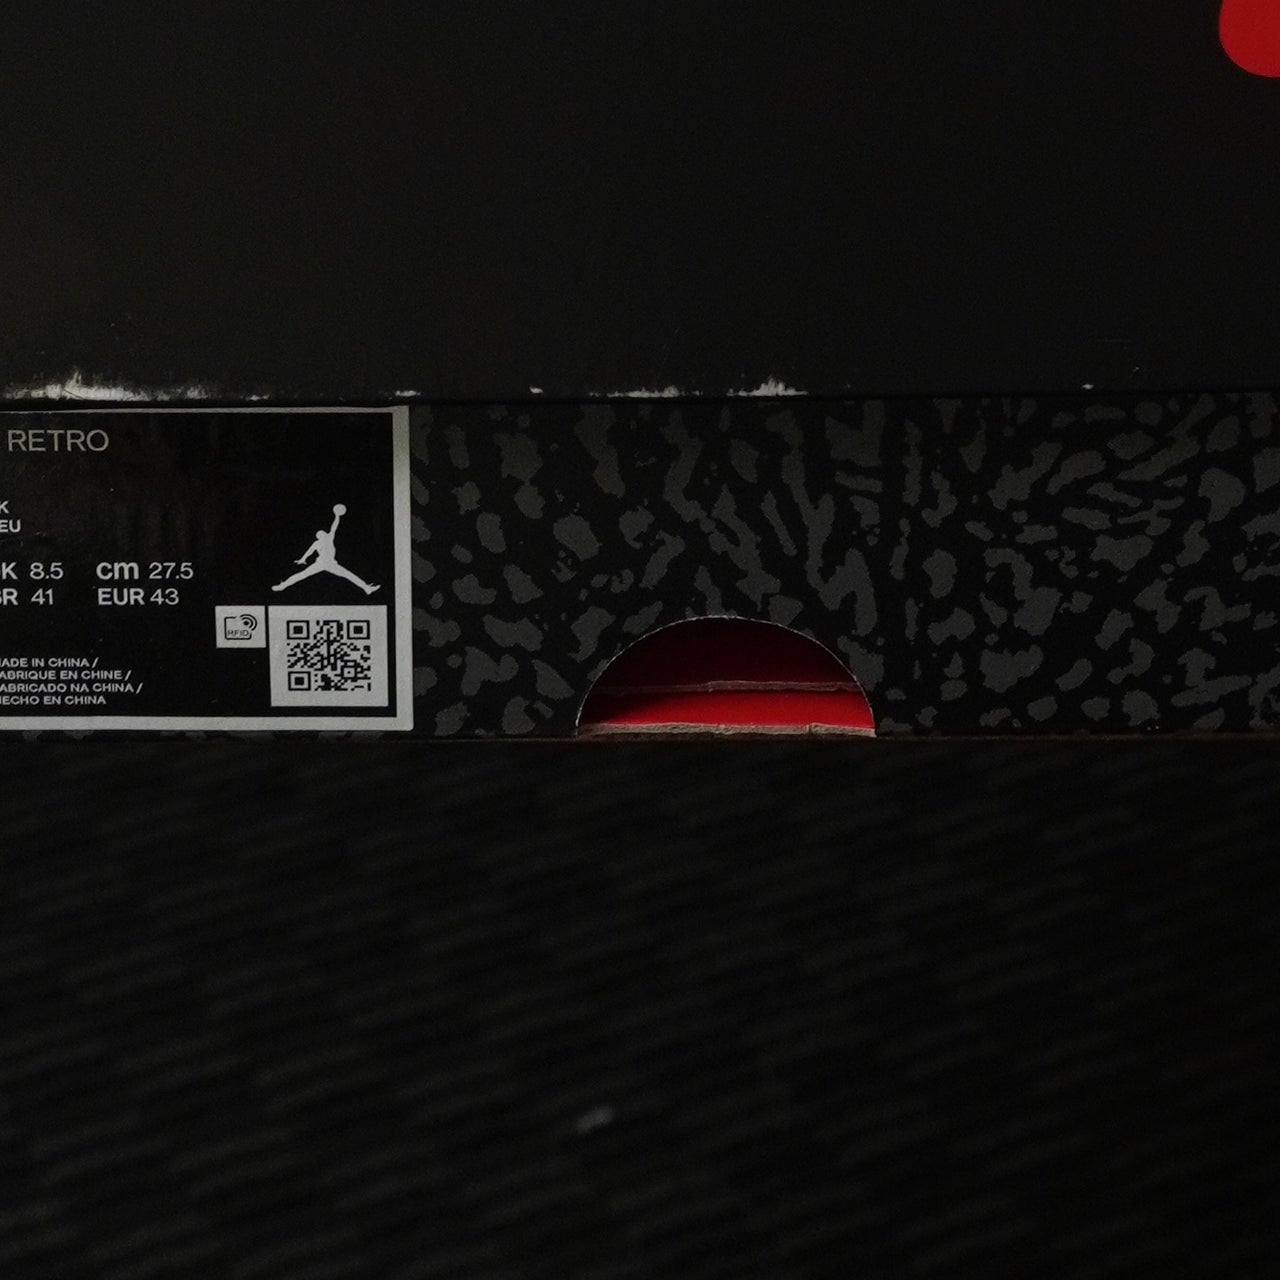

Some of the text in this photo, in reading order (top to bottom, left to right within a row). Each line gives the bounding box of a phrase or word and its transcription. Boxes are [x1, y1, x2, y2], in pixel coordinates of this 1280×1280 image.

[7, 429, 110, 452] RETRO
[29, 561, 64, 580] 8.5
[96, 561, 140, 580] cm
[148, 561, 194, 580] 27.5
[30, 588, 55, 605] 41
[97, 587, 145, 606] EUR
[150, 587, 180, 606] 43
[31, 657, 45, 668] IN
[47, 657, 90, 668] CHINA
[59, 670, 78, 680] EN
[81, 669, 123, 680] CHINE
[70, 682, 90, 693] NA
[92, 682, 134, 693] CHINA
[43, 695, 62, 705] EN
[64, 695, 107, 706] CHINA
